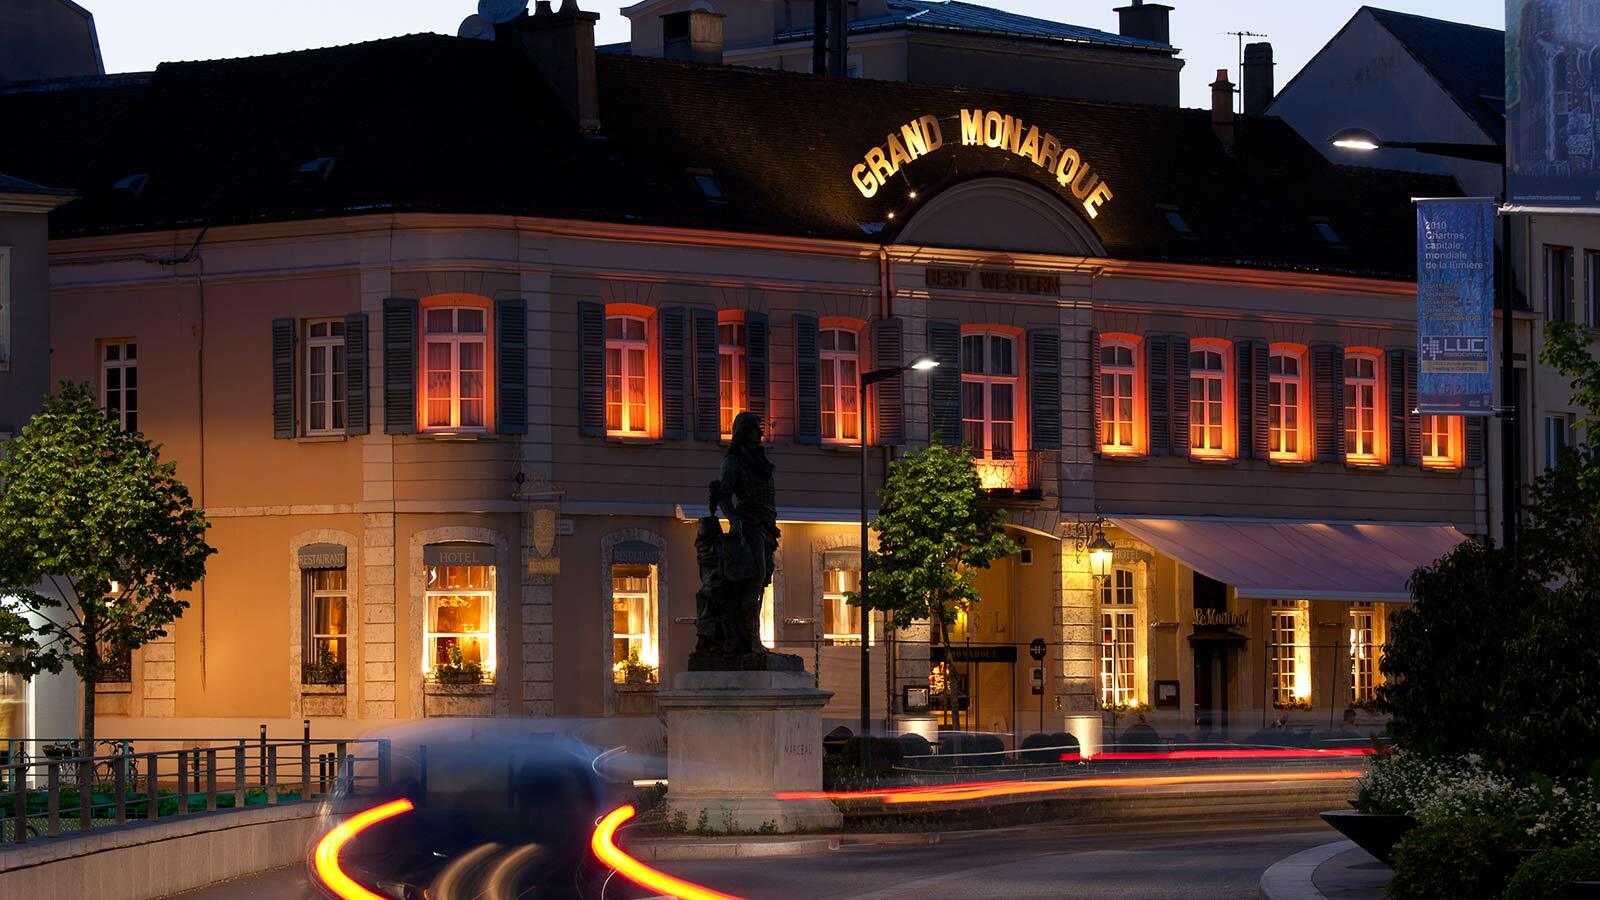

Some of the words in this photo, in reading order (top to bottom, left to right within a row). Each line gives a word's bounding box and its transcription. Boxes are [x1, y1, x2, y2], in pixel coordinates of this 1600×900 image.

[851, 114, 944, 198] GRAND
[960, 108, 1114, 219] MONARQUE
[1425, 221, 1447, 230] 2010
[1425, 231, 1467, 240] Chartres,
[1425, 241, 1460, 251] capitale
[1425, 251, 1467, 260] mondiale
[1425, 261, 1437, 270] de
[1439, 261, 1447, 270] la
[926, 268, 970, 288] BEST
[979, 271, 1061, 296] WESTERN
[1444, 338, 1488, 352] LUCI
[299, 553, 345, 565] RESTAURANT
[439, 551, 479, 562] HOTEL
